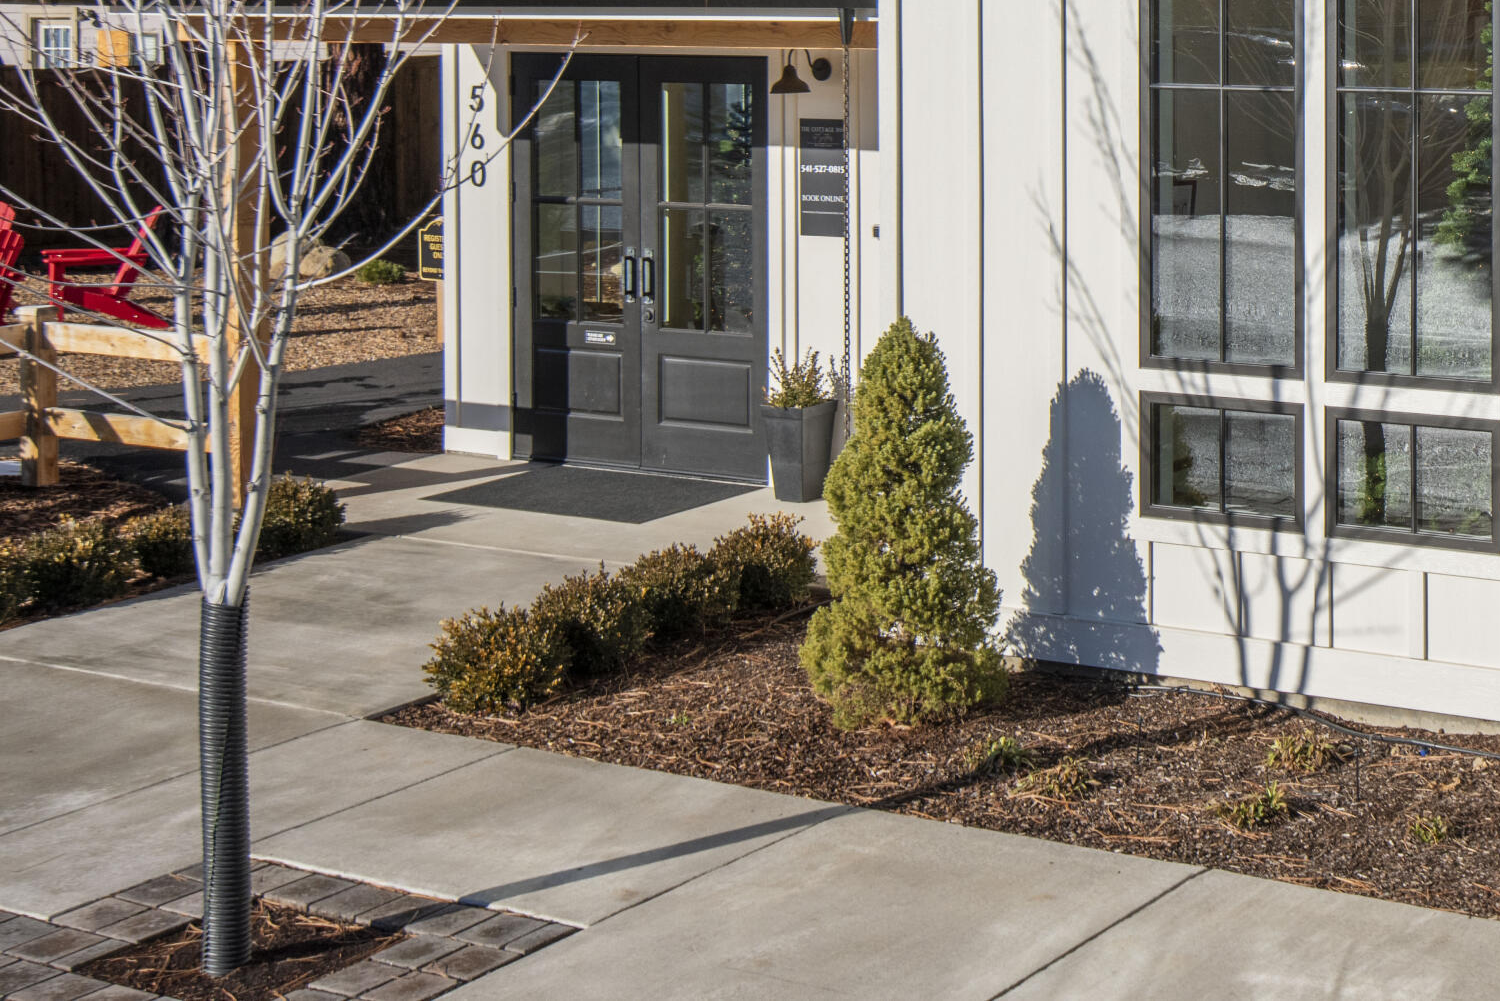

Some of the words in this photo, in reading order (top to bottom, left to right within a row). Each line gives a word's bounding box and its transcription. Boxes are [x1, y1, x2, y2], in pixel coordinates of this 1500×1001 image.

[469, 84, 487, 187] 560
[800, 164, 846, 174] 541-527-0815
[801, 194, 820, 202] BOOK
[820, 195, 845, 203] ONLINE
